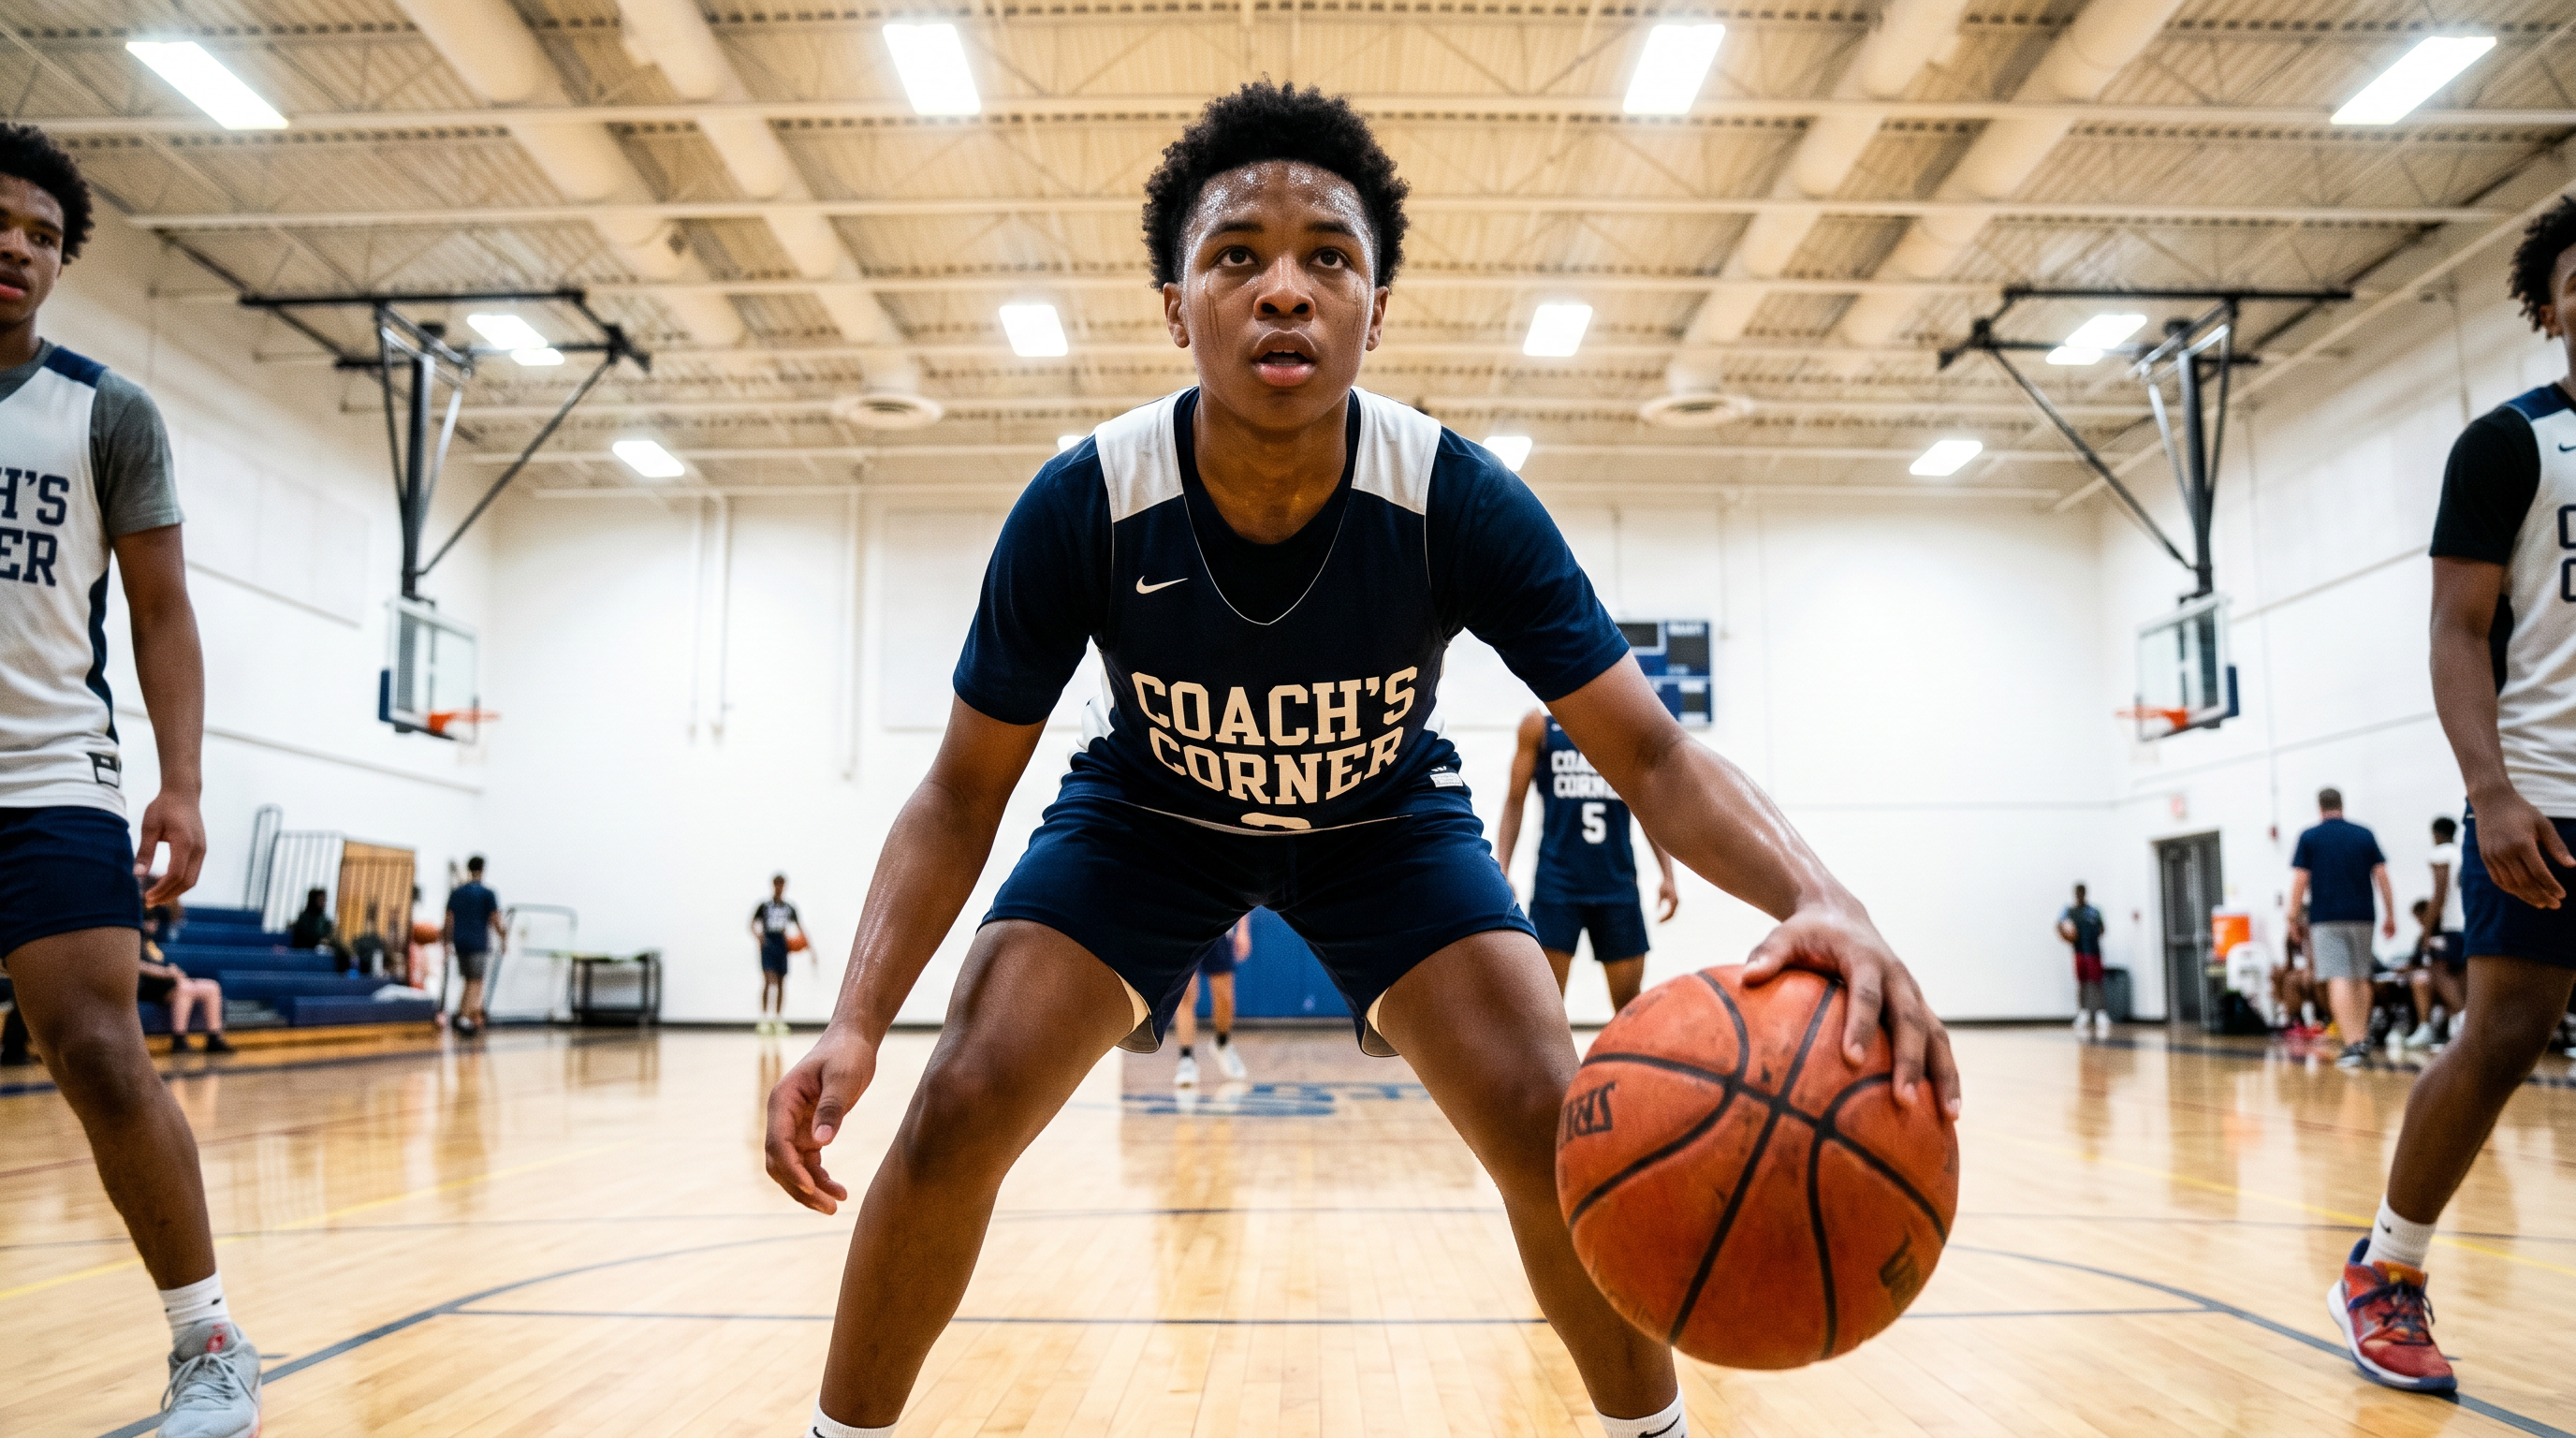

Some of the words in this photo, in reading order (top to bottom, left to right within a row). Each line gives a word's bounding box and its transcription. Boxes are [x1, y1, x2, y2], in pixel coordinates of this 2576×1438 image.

[1131, 666, 1418, 746] COACH'S
[1149, 726, 1404, 805] CORNER
[1581, 801, 1607, 844] 5
